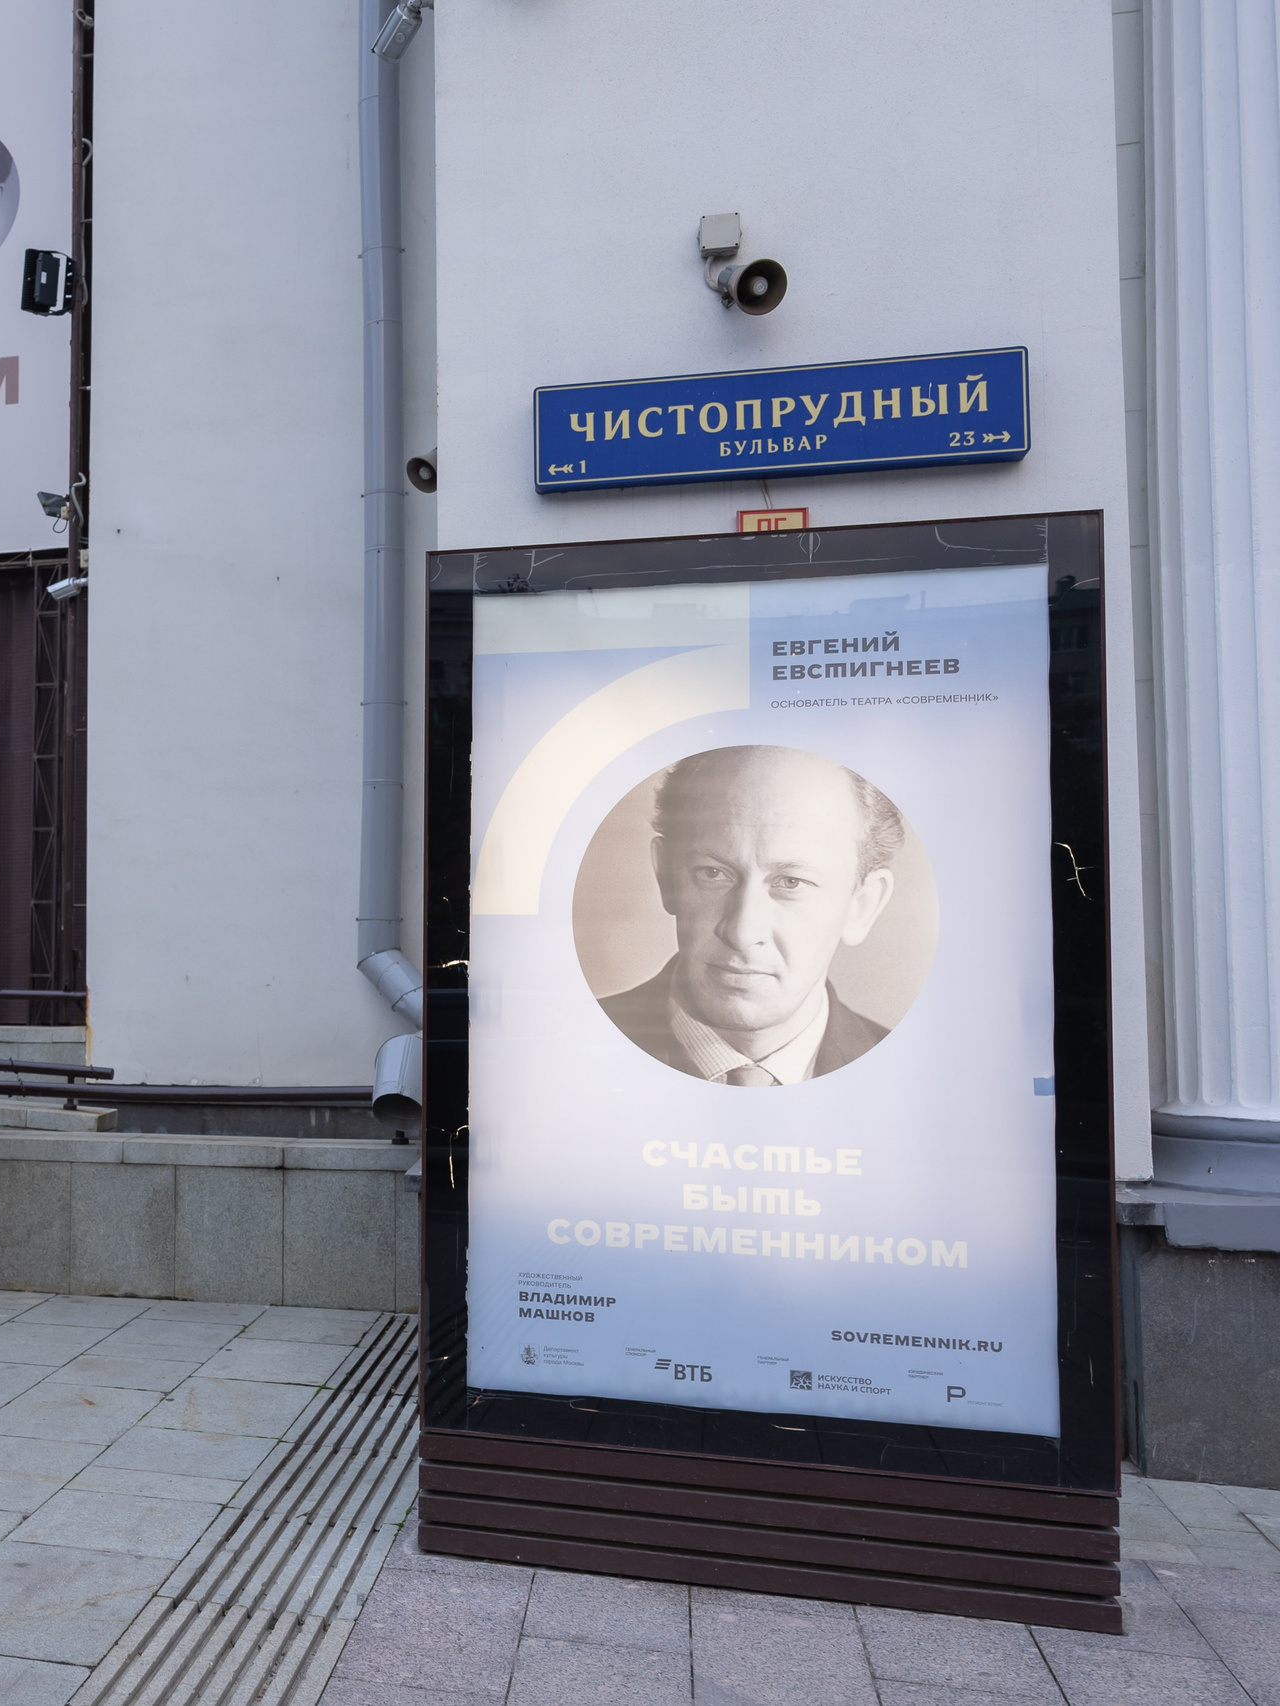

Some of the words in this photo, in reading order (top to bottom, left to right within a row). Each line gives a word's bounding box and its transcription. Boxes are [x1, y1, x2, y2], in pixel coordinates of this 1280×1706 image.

[569, 373, 989, 443] ЧИСТОПРУДНЫЙ
[719, 433, 828, 458] БУЛЬВАР
[949, 430, 976, 448] 23
[580, 458, 587, 475] 1
[772, 630, 901, 657] ЕВГЕНИЙ
[772, 658, 961, 681] ЕВСТИГНЕЕВ
[771, 697, 848, 710] ОСНОВАТЕЛЬ
[850, 695, 892, 708] ТЕАТРА
[895, 692, 999, 706] «СОВРЕМЕННИК»
[642, 1140, 862, 1177] СЧАСТЬЕ
[682, 1183, 822, 1217] БЫТЬ
[546, 1218, 969, 1268] СОВРЕМЕННИКОМ
[518, 1272, 583, 1282] ХУДОЖЕСТВЕННЫЙ
[518, 1280, 571, 1289] РУКОВОДИТЕЛЬ
[519, 1291, 617, 1308] ВЛАДИМИР
[519, 1307, 595, 1323] МАШКОВ
[831, 1330, 1003, 1353] SOVREMENNIK.RU
[674, 1363, 713, 1382] ВТБ
[818, 1374, 872, 1386] ИСКУССТВО
[818, 1382, 850, 1392] НАУКА
[851, 1384, 858, 1392] И
[859, 1385, 892, 1395] СПОРТ
